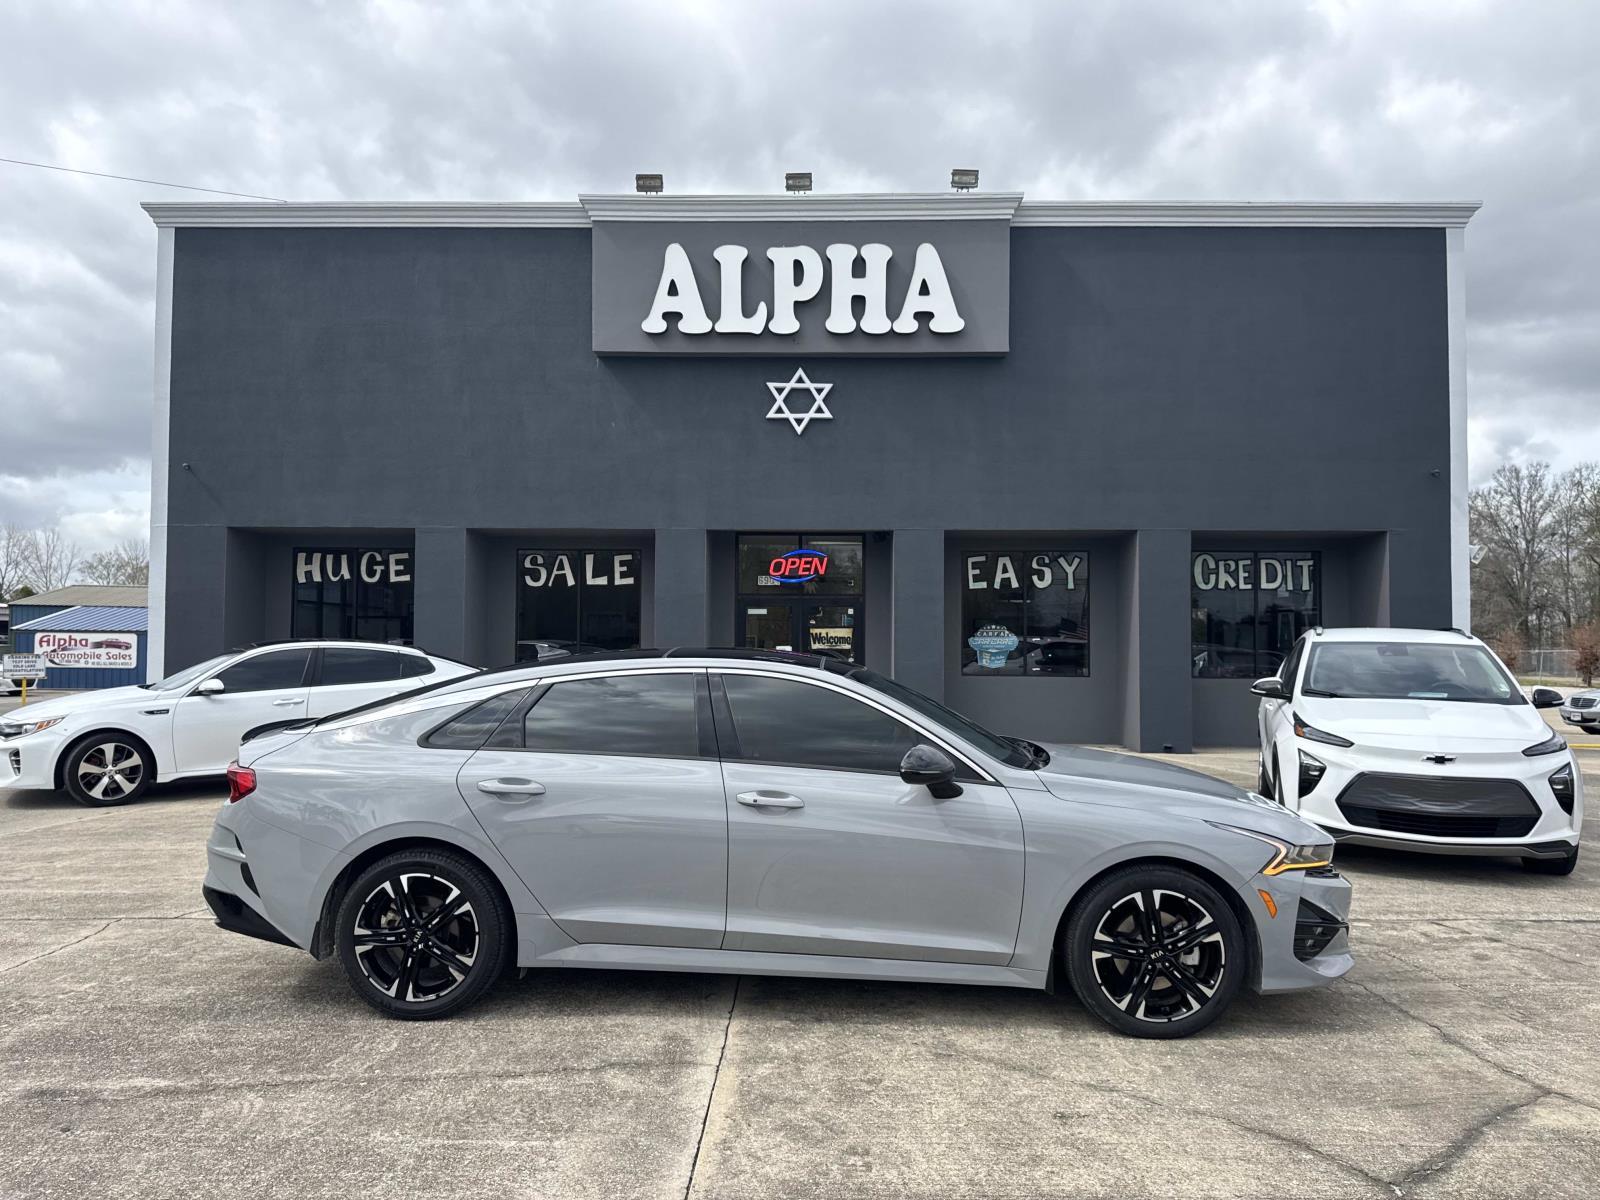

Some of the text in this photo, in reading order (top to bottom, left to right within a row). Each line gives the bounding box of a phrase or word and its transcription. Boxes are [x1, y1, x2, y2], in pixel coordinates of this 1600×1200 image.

[640, 242, 966, 335] ALPHA
[296, 551, 635, 587] HUGE SALE
[769, 556, 828, 575] OPEN
[966, 553, 1314, 591] EASY CREDIT
[38, 634, 89, 649] Alpha
[810, 632, 851, 645] Welcome
[106, 651, 133, 661] Sales
